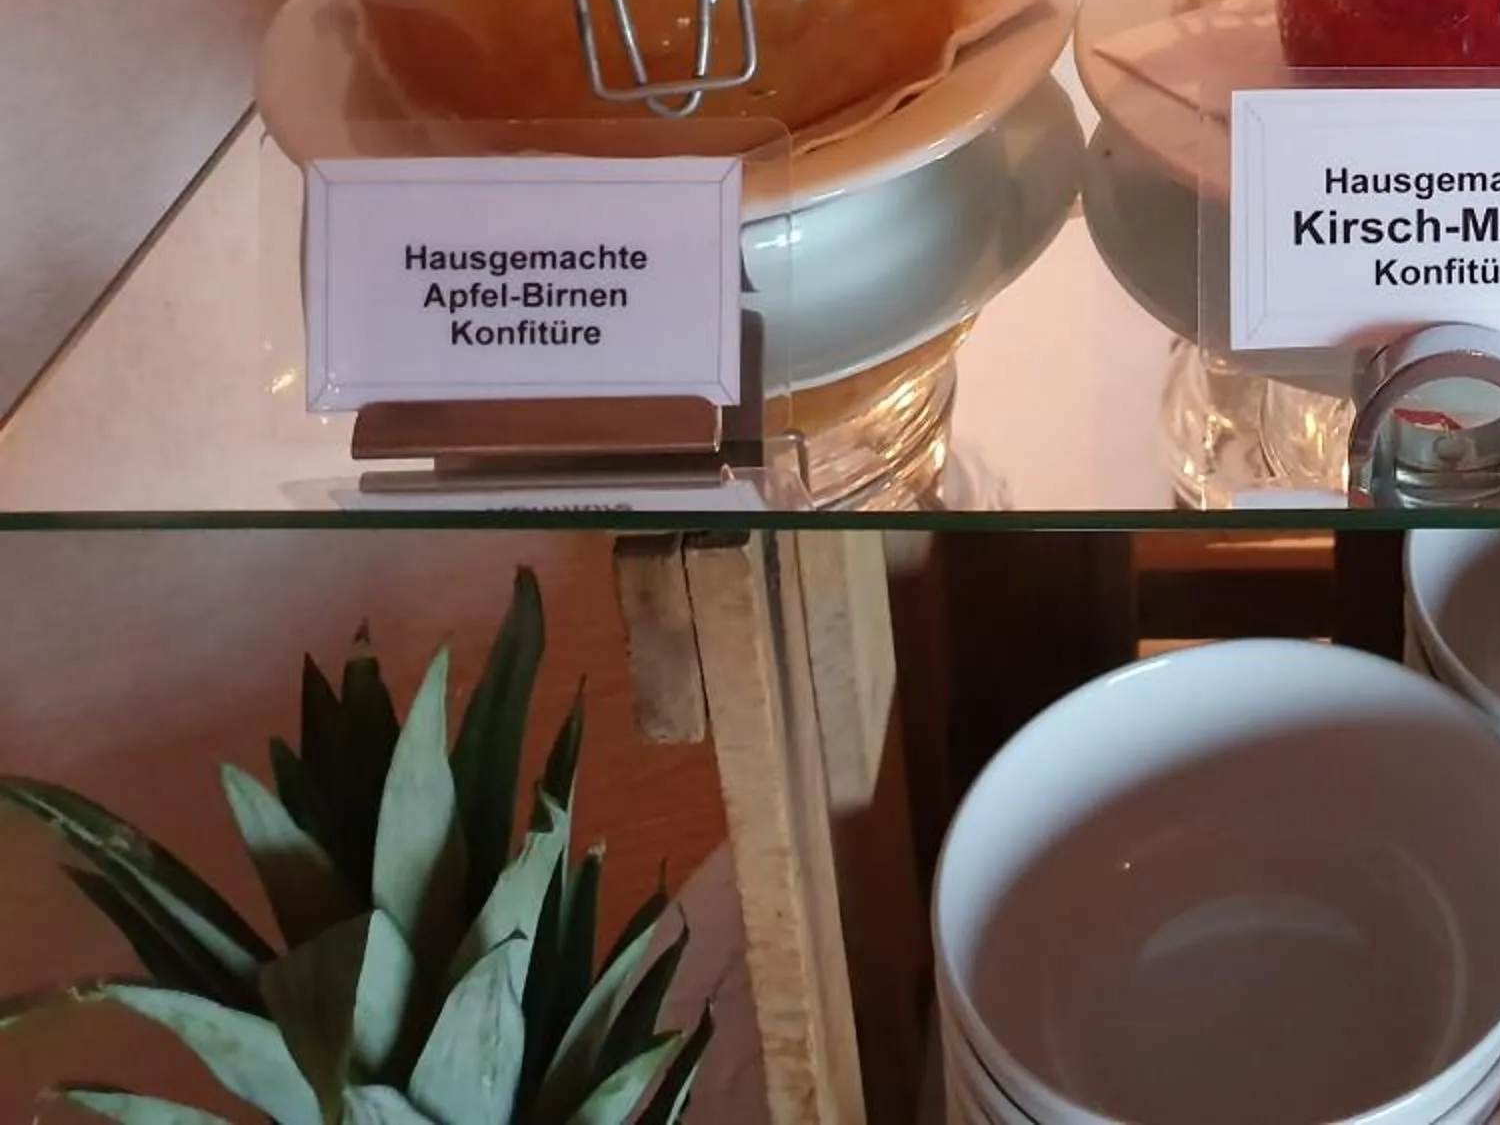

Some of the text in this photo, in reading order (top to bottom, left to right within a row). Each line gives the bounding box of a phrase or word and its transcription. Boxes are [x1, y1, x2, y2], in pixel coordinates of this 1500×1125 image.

[404, 243, 648, 276] Hausgemachte
[423, 282, 628, 314] Apfel-Birnen
[450, 319, 601, 346] Konfitüre
